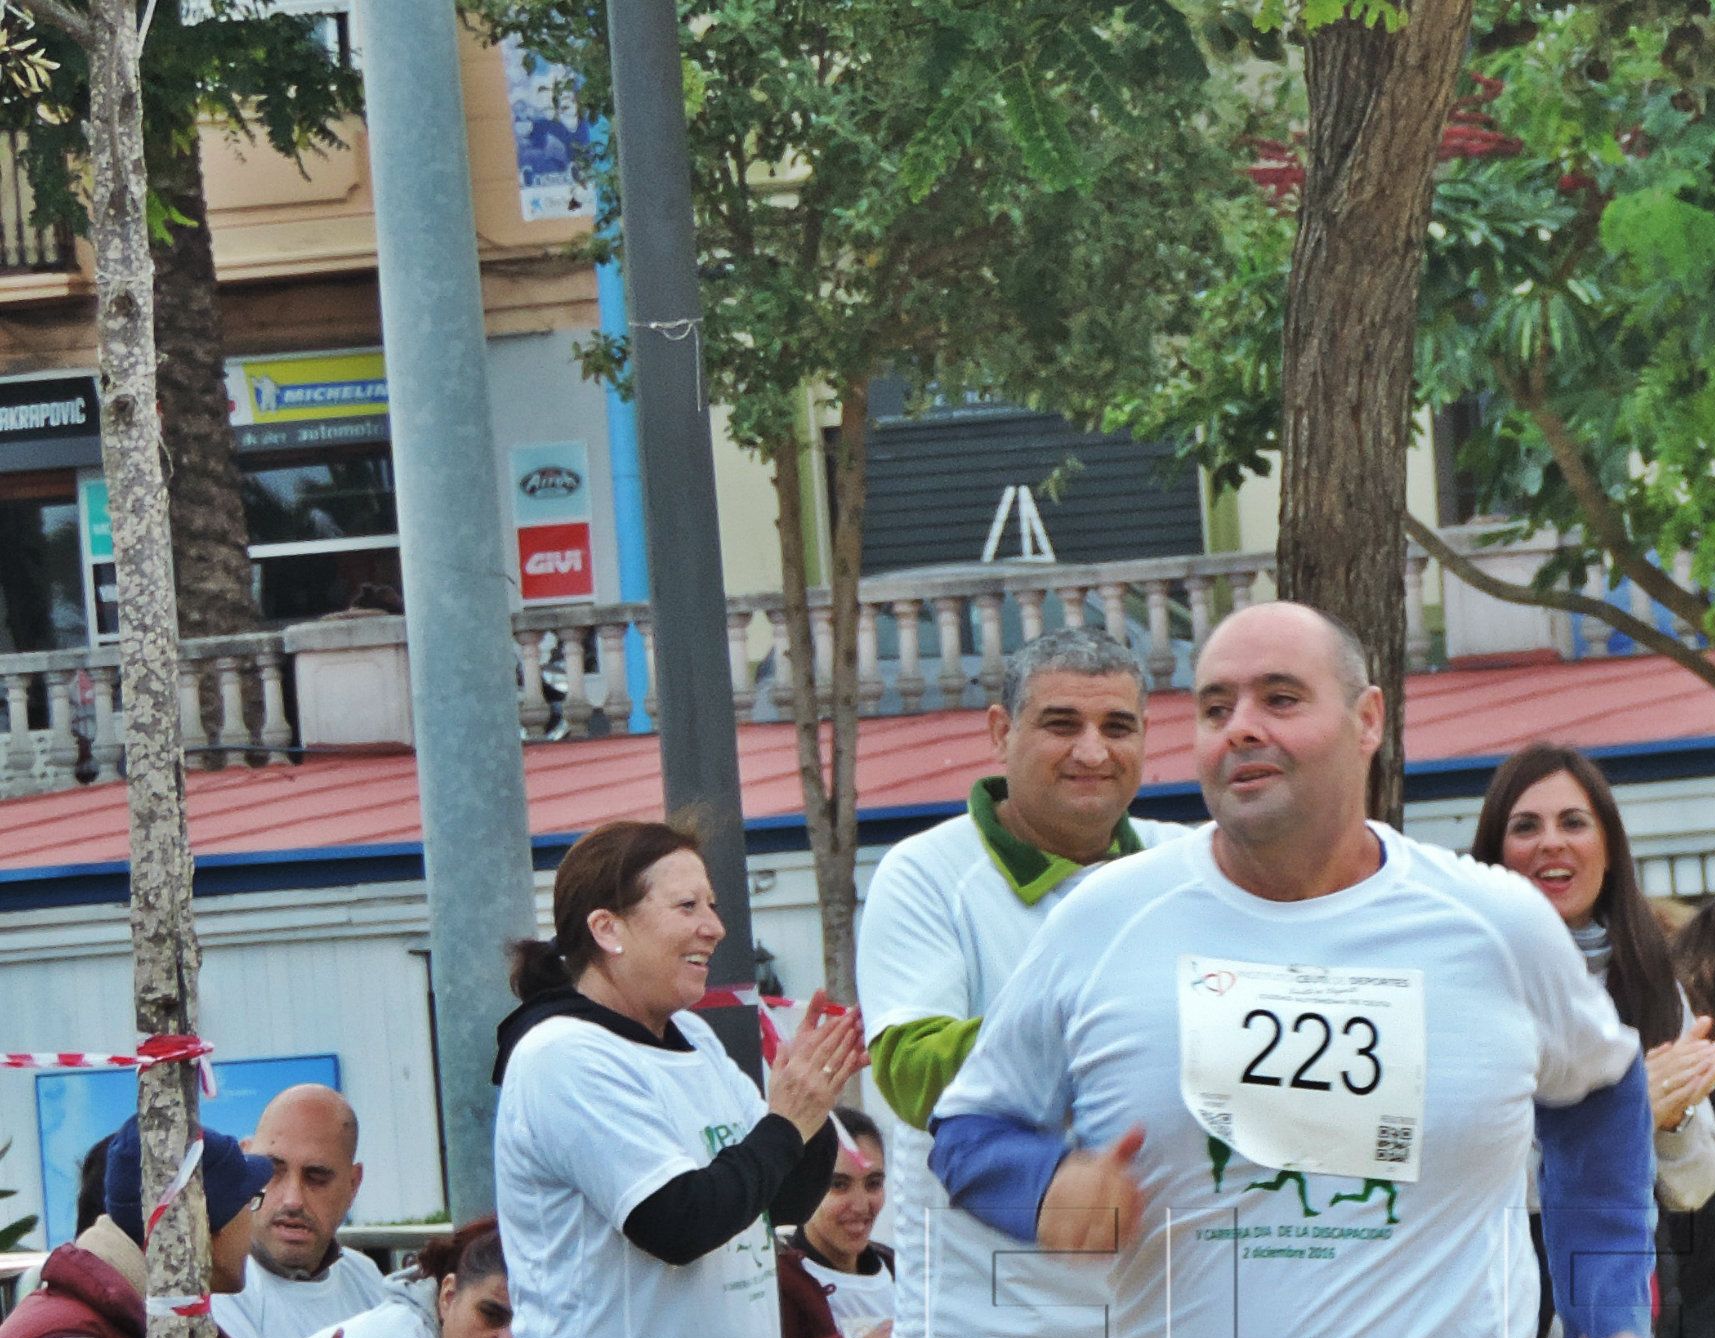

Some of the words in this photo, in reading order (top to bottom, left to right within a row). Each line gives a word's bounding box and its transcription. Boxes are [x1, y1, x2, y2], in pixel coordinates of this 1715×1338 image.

[283, 383, 388, 403] MICHELIN
[525, 549, 582, 575] GIVI
[1241, 1008, 1382, 1096] 223
[1277, 1225, 1292, 1238] DE
[1294, 1225, 1309, 1238] LA
